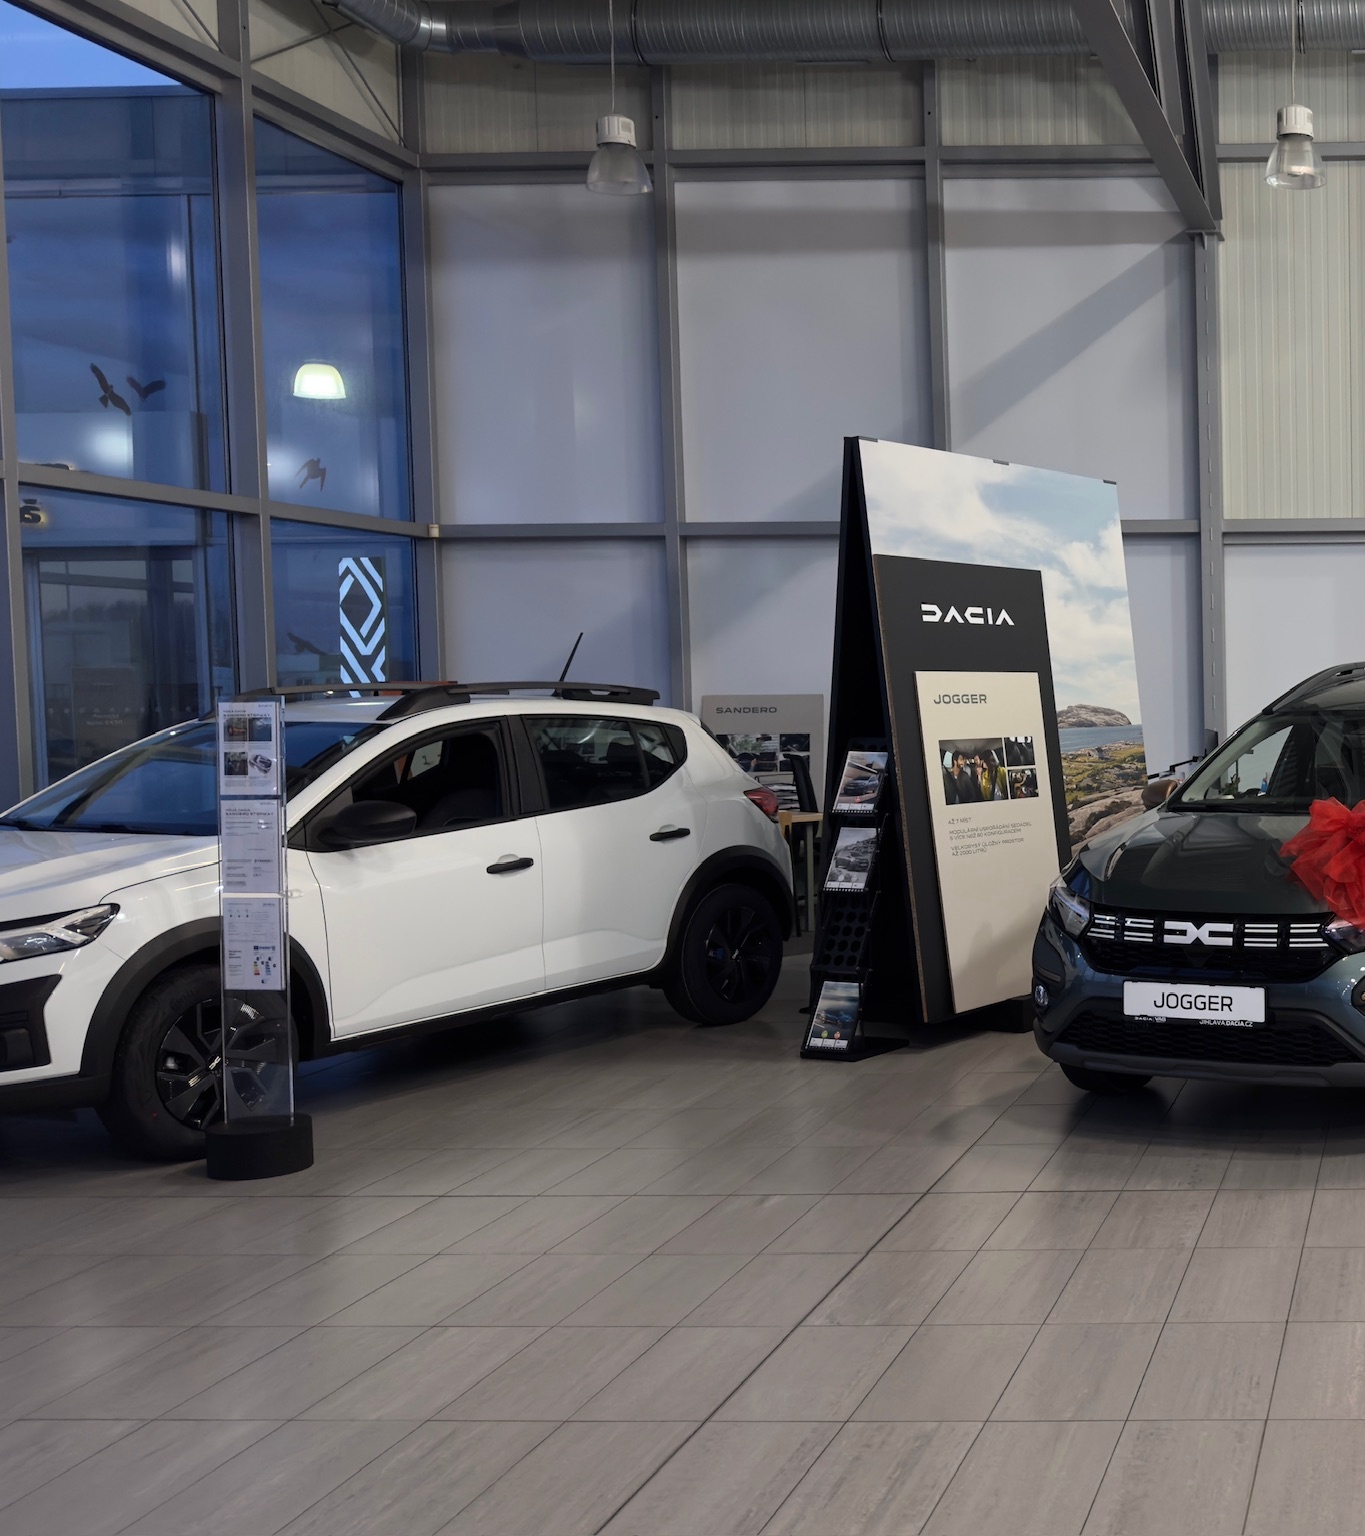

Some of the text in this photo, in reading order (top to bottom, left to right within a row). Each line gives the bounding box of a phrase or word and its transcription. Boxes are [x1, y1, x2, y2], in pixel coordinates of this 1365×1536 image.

[921, 603, 1015, 626] DACIA
[933, 694, 988, 704] JOGGER
[715, 706, 778, 714] SANDERO
[1153, 991, 1234, 1012] JOGGER
